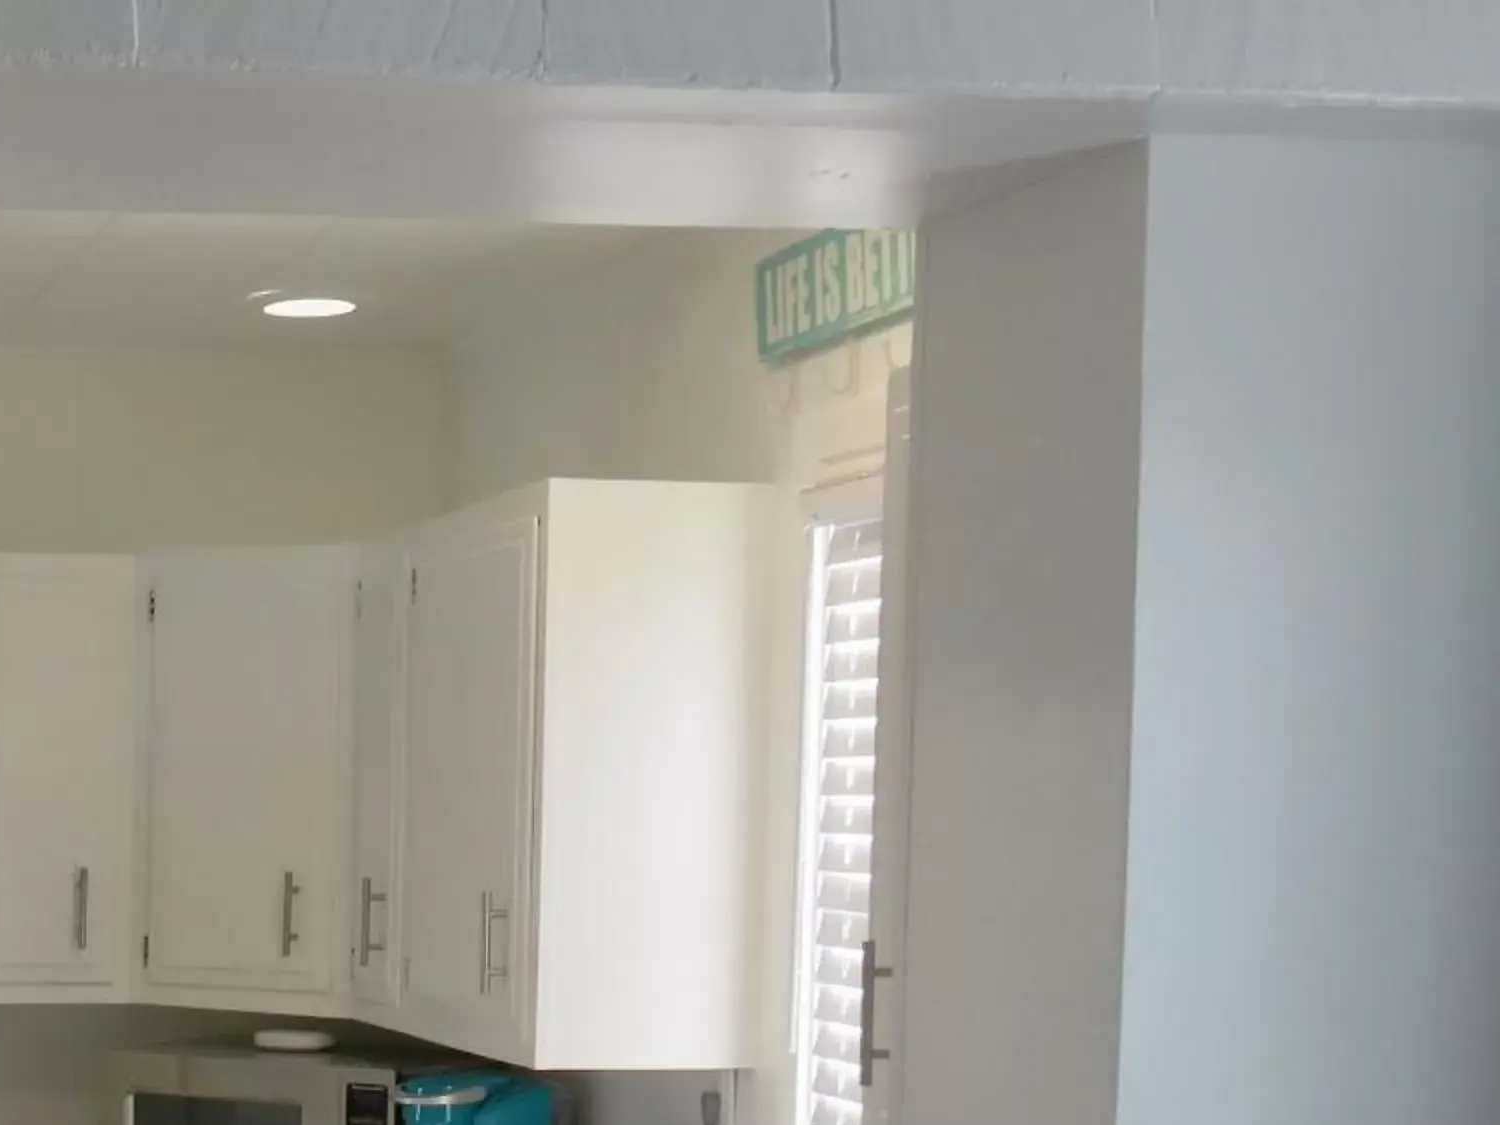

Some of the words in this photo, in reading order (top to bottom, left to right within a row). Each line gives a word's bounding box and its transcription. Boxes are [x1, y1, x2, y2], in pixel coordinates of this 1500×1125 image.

[764, 251, 811, 344] LIFE
[814, 239, 841, 327] IS
[845, 229, 916, 315] BETT
